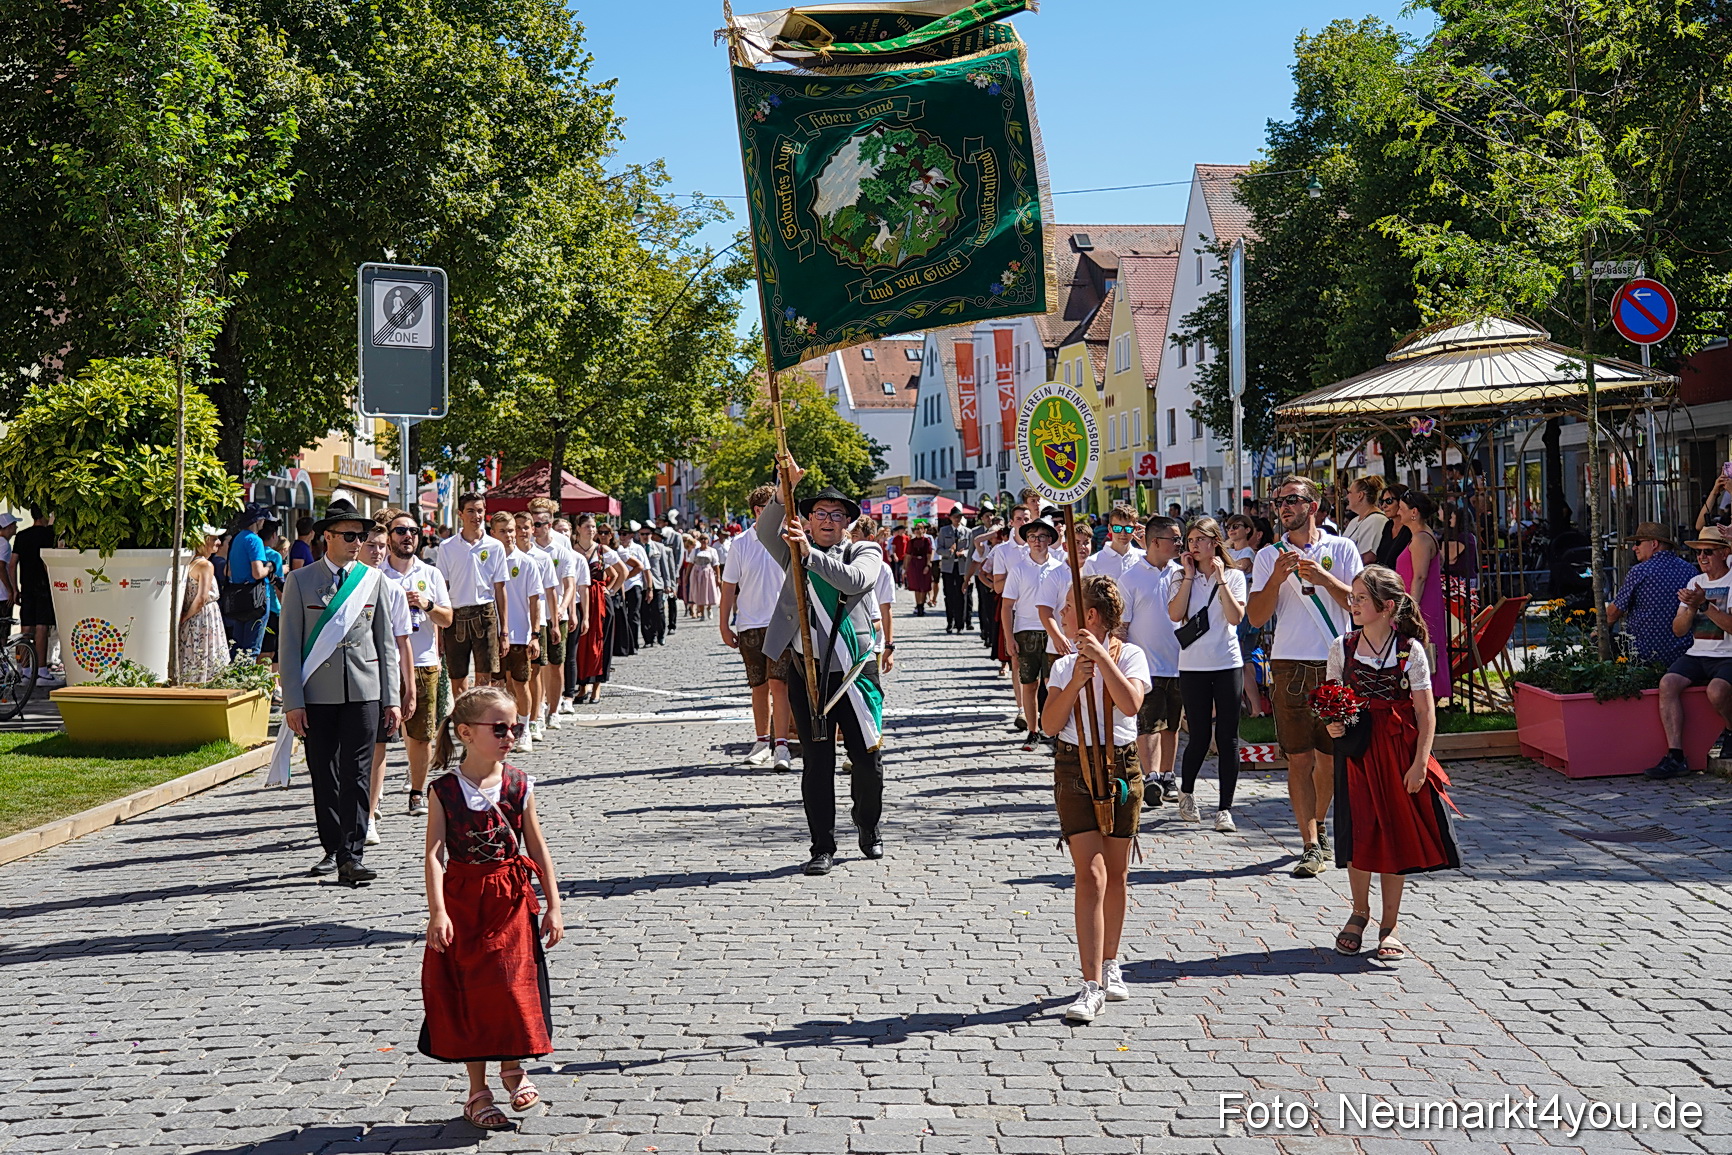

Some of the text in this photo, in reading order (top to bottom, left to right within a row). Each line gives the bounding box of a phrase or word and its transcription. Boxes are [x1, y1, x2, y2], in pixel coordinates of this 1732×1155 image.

[857, 99, 894, 120] Hand
[775, 140, 798, 240] Scharfes Auge
[868, 256, 962, 301] und viel Glück
[1606, 264, 1634, 275] Gasse
[388, 331, 419, 344] ZONE
[997, 361, 1015, 411] SALE
[1057, 385, 1100, 462] HEINRICHSBURG
[1036, 476, 1092, 502] HOLZHEIM
